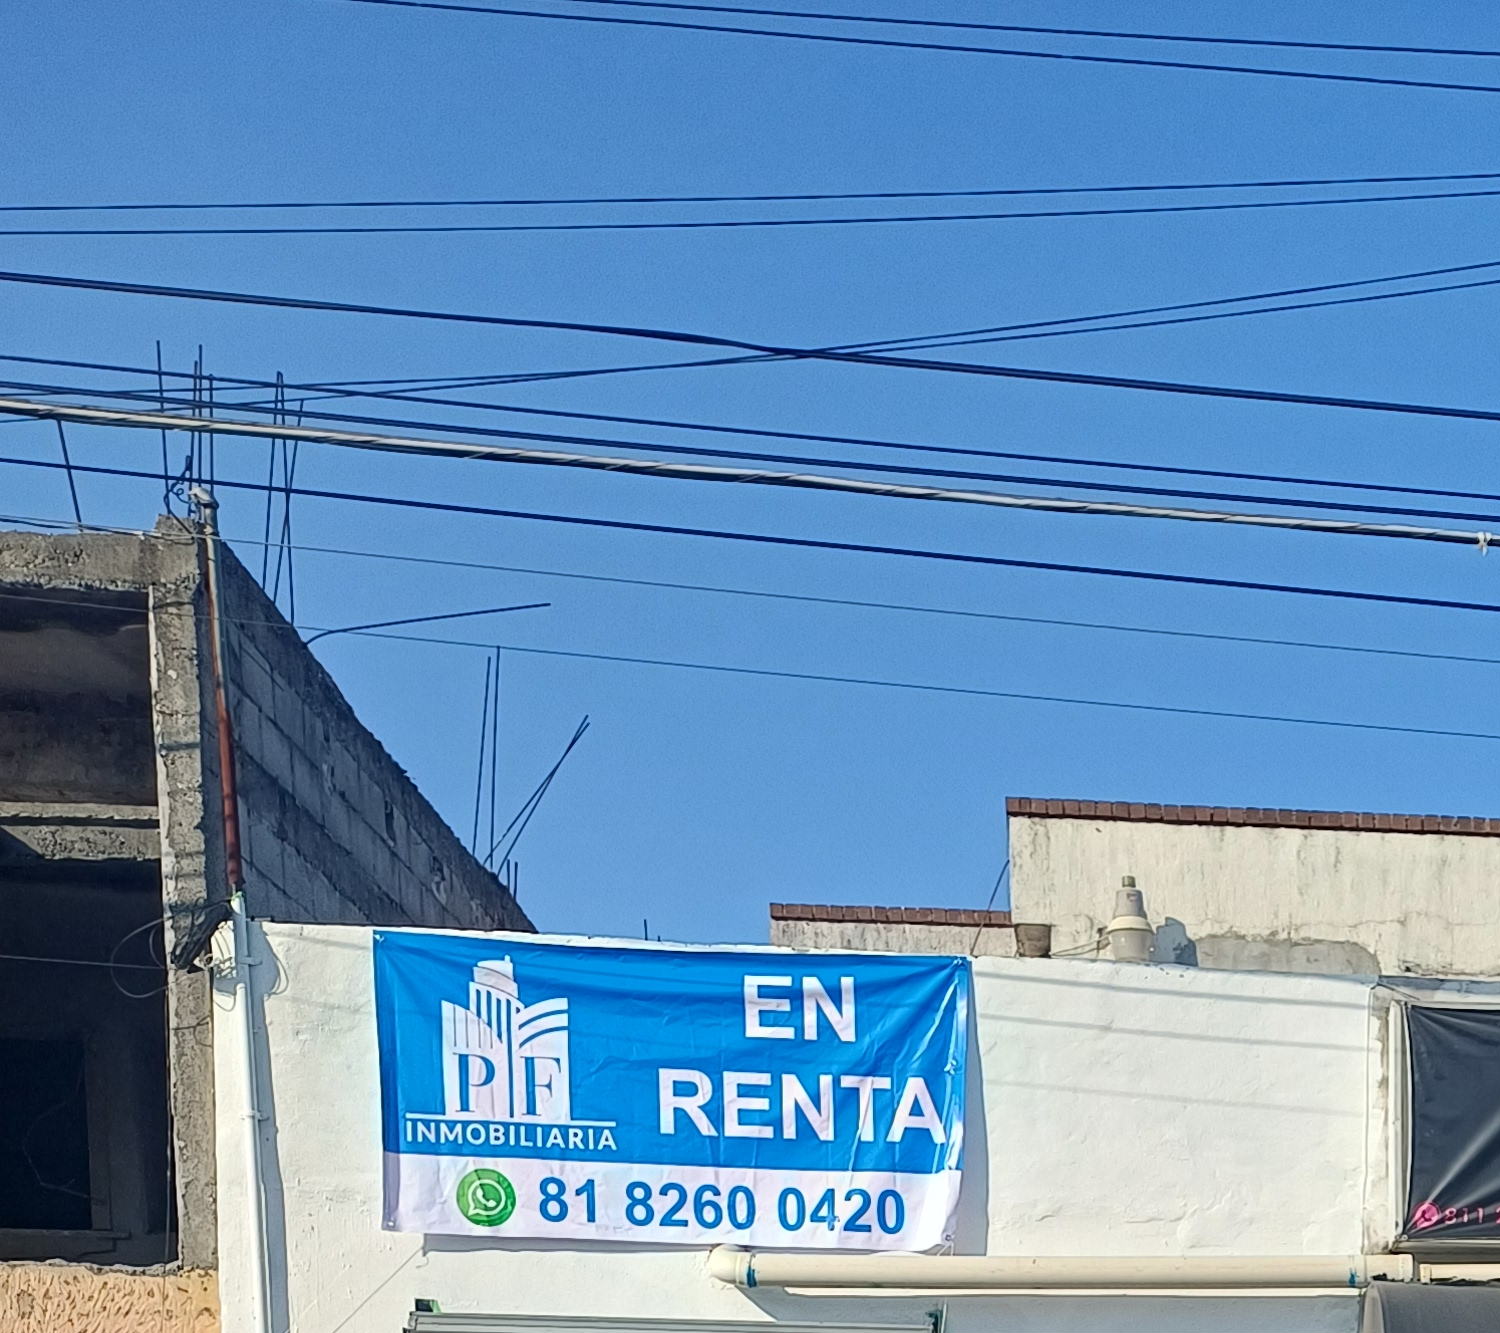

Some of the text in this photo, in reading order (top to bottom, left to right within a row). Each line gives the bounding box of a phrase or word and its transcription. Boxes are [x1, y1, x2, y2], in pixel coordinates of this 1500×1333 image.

[743, 974, 856, 1042] EN
[404, 1119, 618, 1151] INMOBILIARIA
[657, 1067, 946, 1146] RENTA
[538, 1176, 905, 1234] 81 8260 0420
